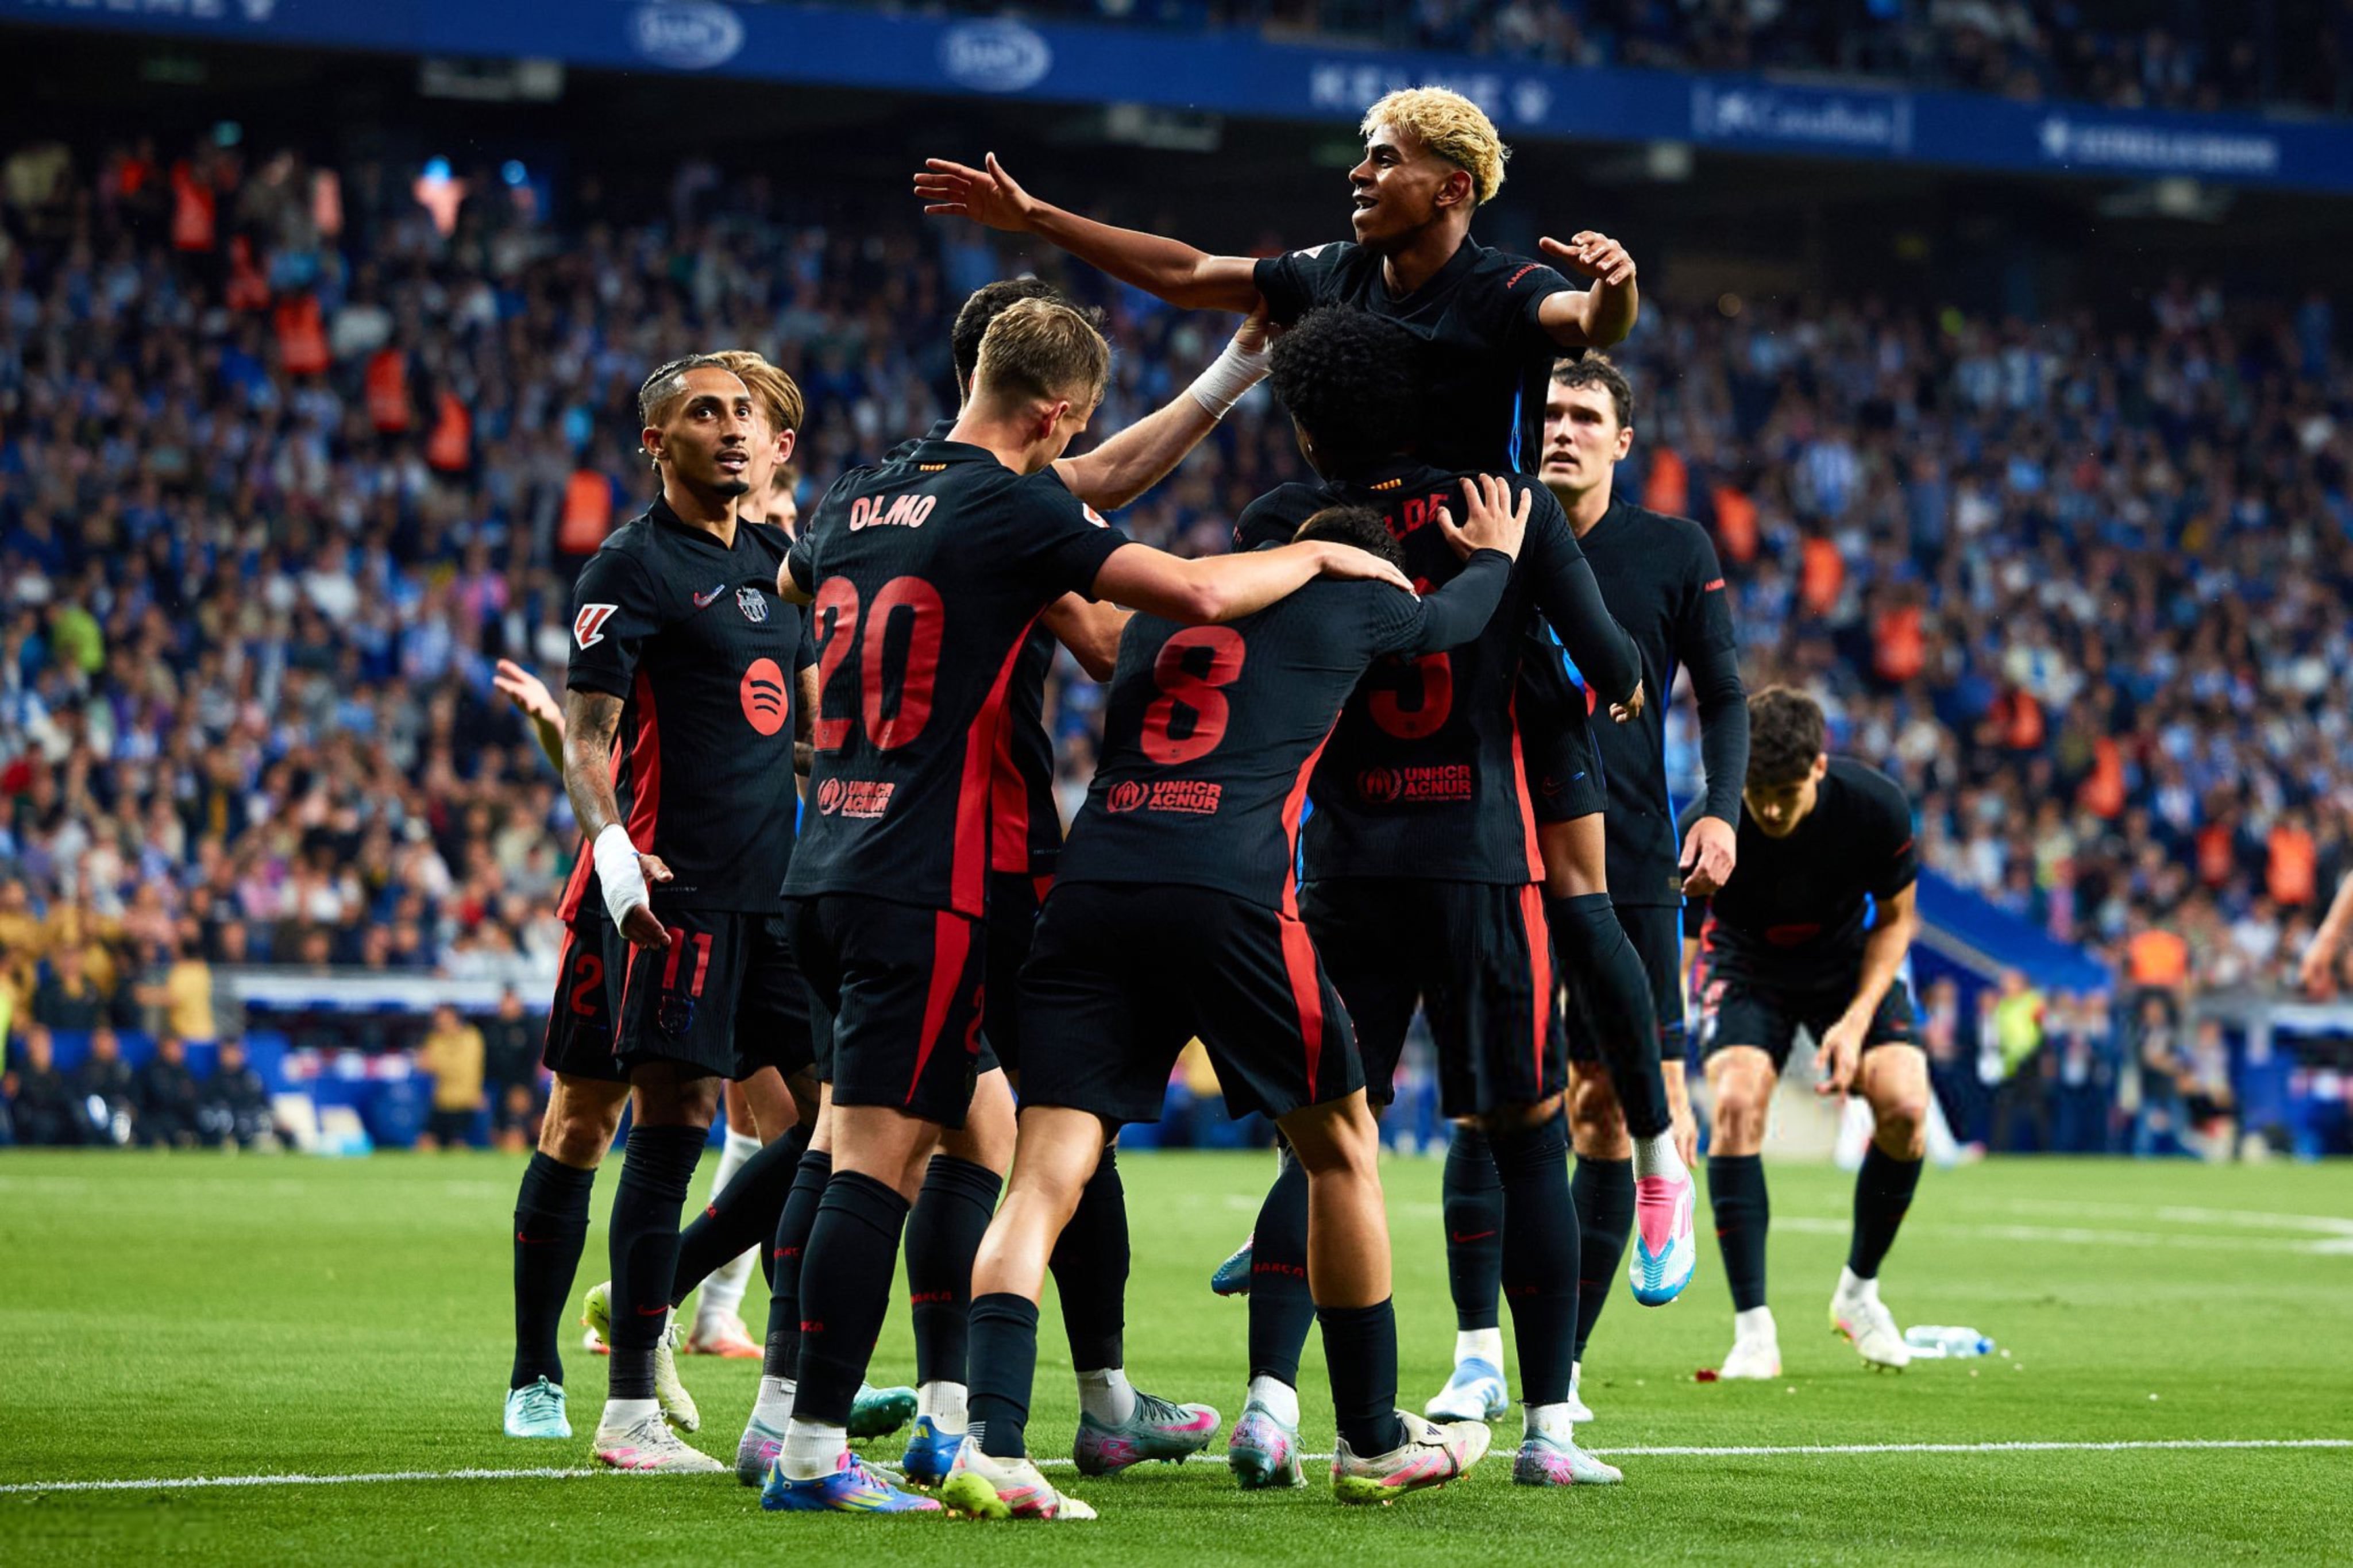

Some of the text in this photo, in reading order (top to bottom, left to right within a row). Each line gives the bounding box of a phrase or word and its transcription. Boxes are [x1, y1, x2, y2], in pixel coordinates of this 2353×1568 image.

[850, 495, 937, 531] OLMO
[813, 576, 944, 752] 20
[1140, 625, 1245, 765] 8
[1405, 764, 1471, 781] UNHCR
[847, 781, 895, 797] UNHCR
[1152, 781, 1222, 798] UNHCR
[1405, 780, 1471, 795] ACNUR
[1148, 793, 1218, 810] ACNUR
[662, 926, 713, 998] 11
[570, 953, 604, 1017] 2
